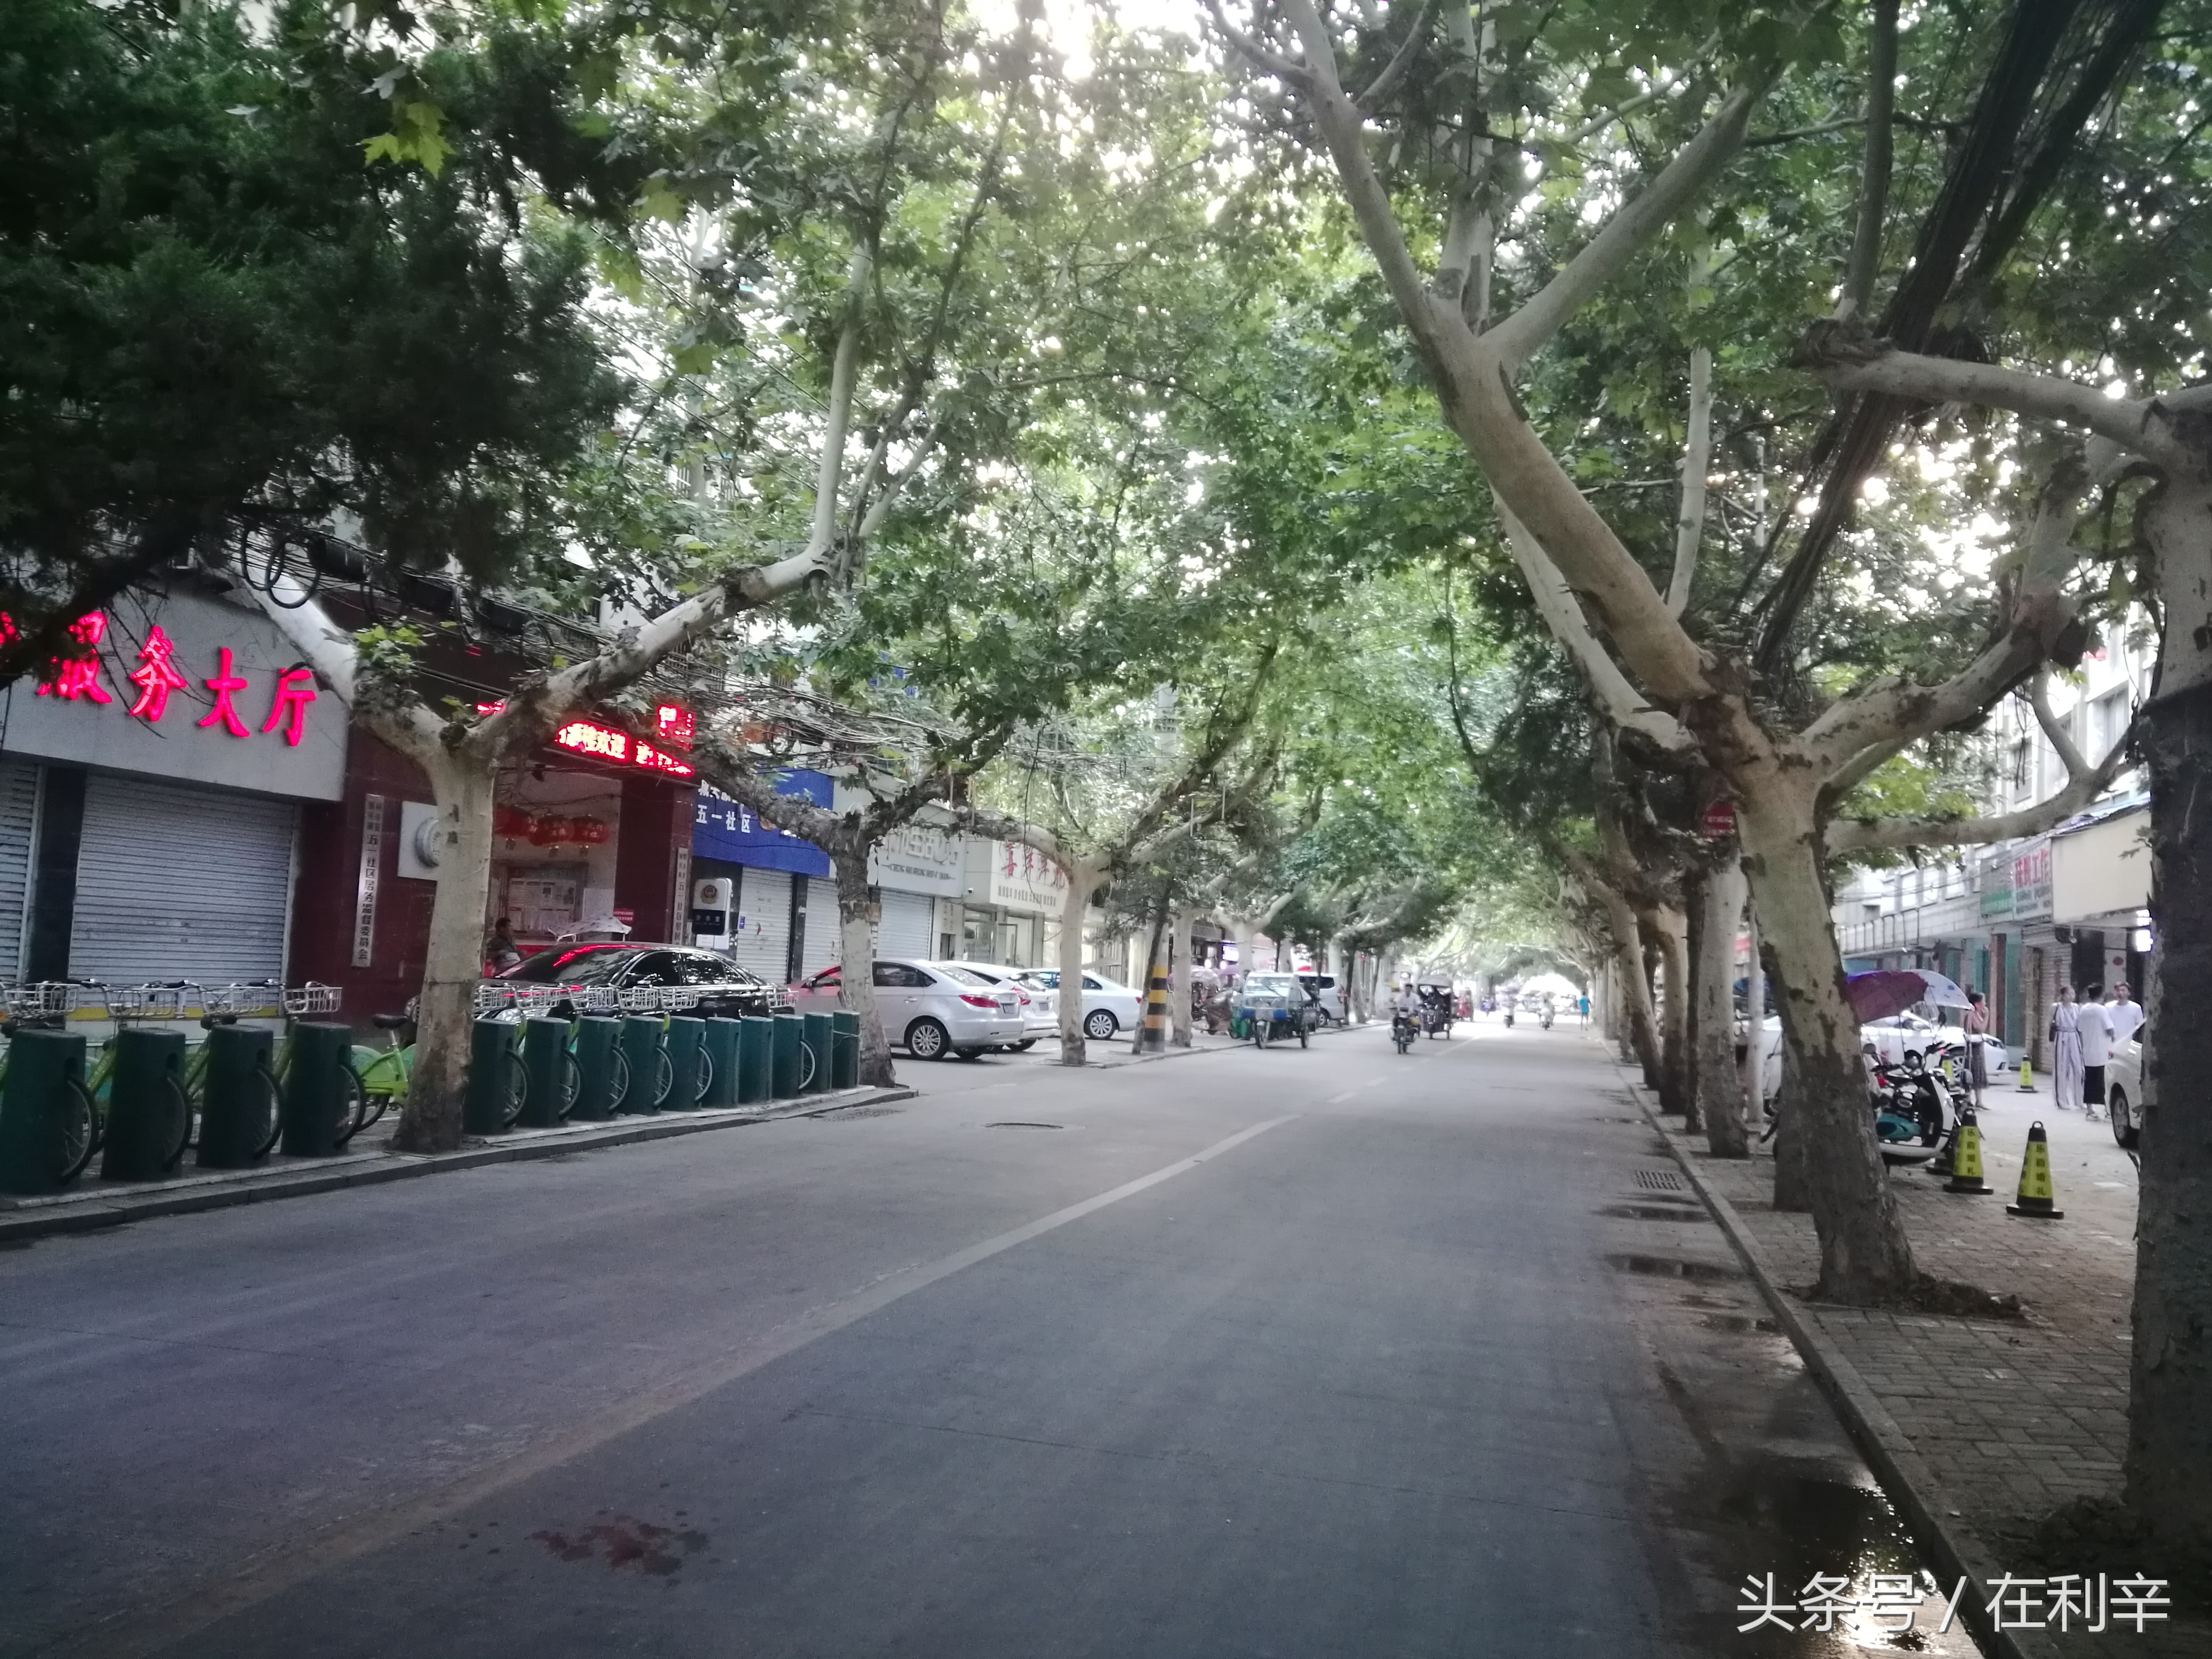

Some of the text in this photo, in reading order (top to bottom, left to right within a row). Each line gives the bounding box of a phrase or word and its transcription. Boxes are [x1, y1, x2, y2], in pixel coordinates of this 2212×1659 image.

[0, 611, 317, 747] 服务大厅
[696, 803, 751, 834] 五一社区
